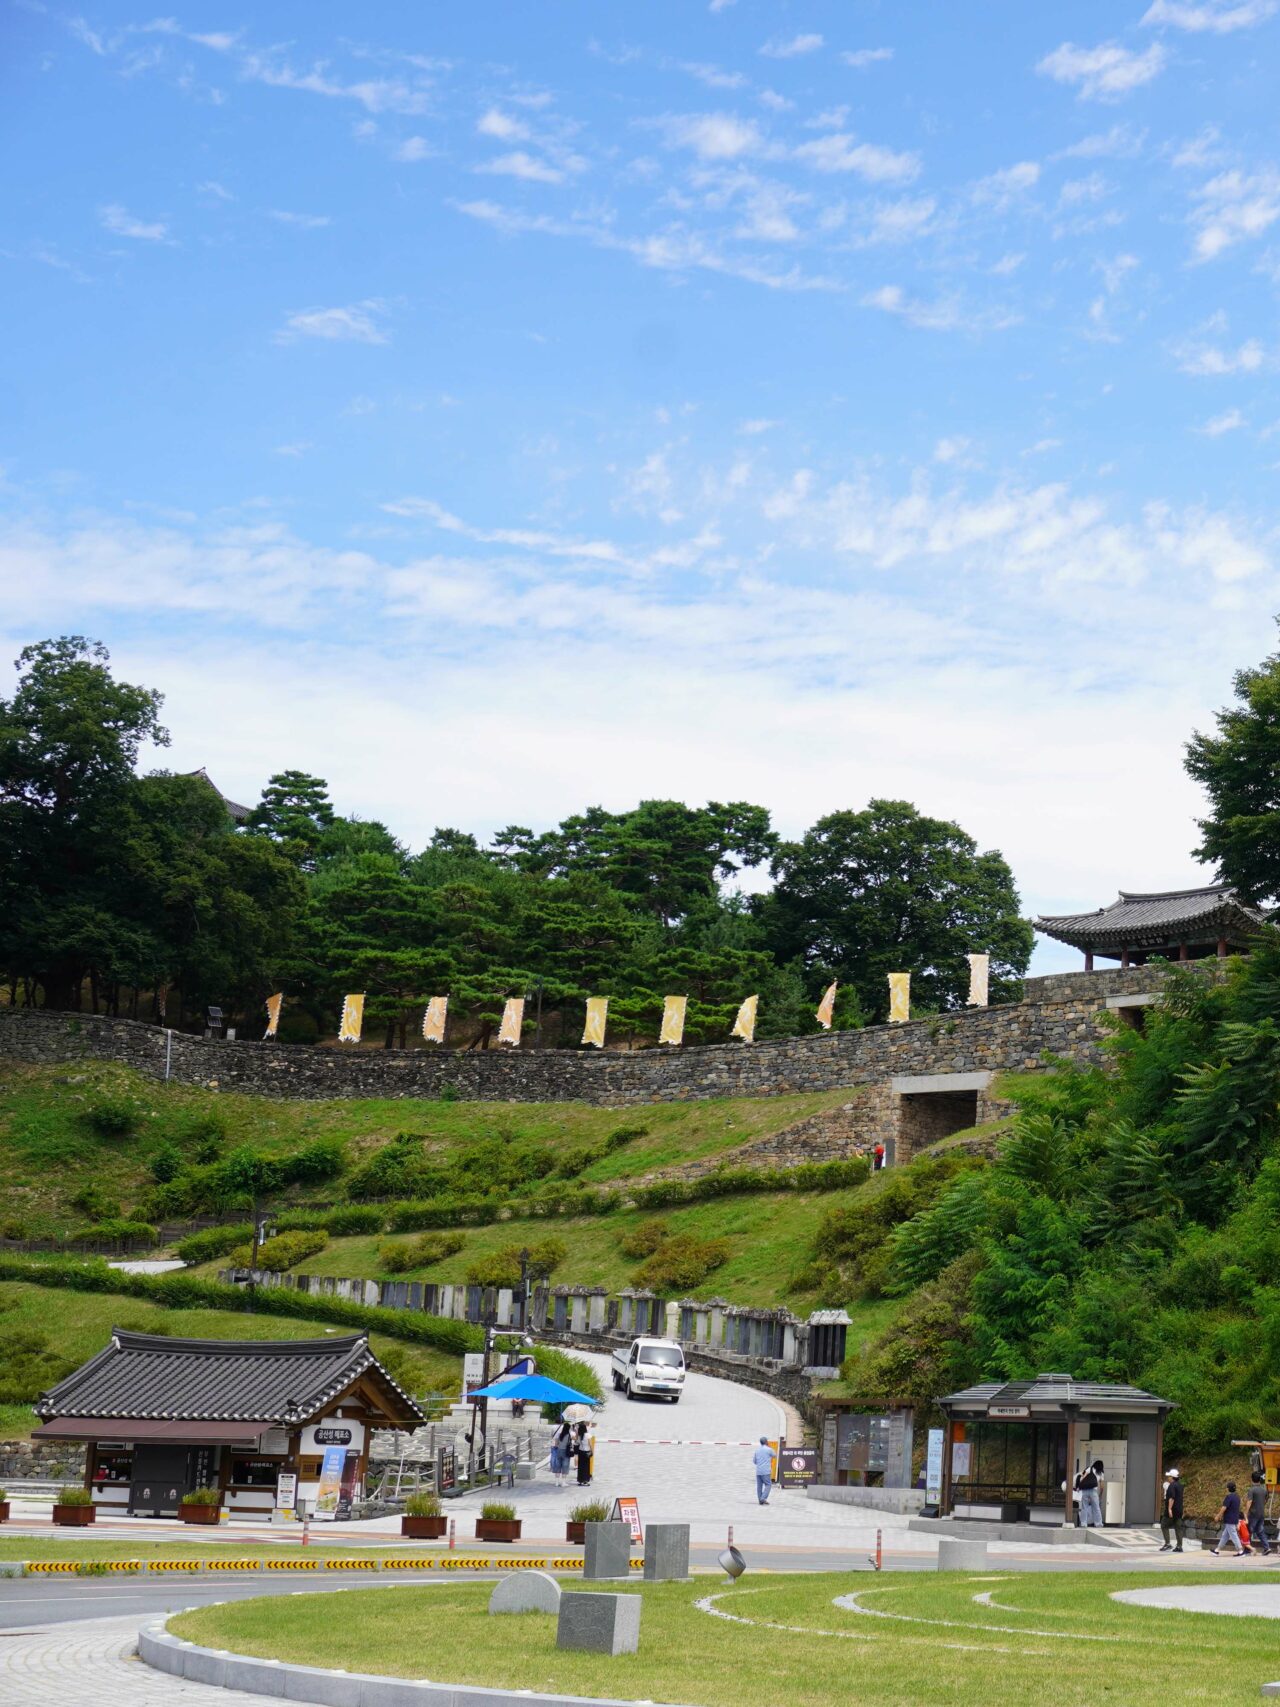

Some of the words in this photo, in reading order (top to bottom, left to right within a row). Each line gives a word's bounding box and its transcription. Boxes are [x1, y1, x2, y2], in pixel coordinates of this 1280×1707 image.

[318, 1429, 334, 1439] 공산성
[334, 1429, 350, 1439] 매표소
[623, 1508, 636, 1517] 차량
